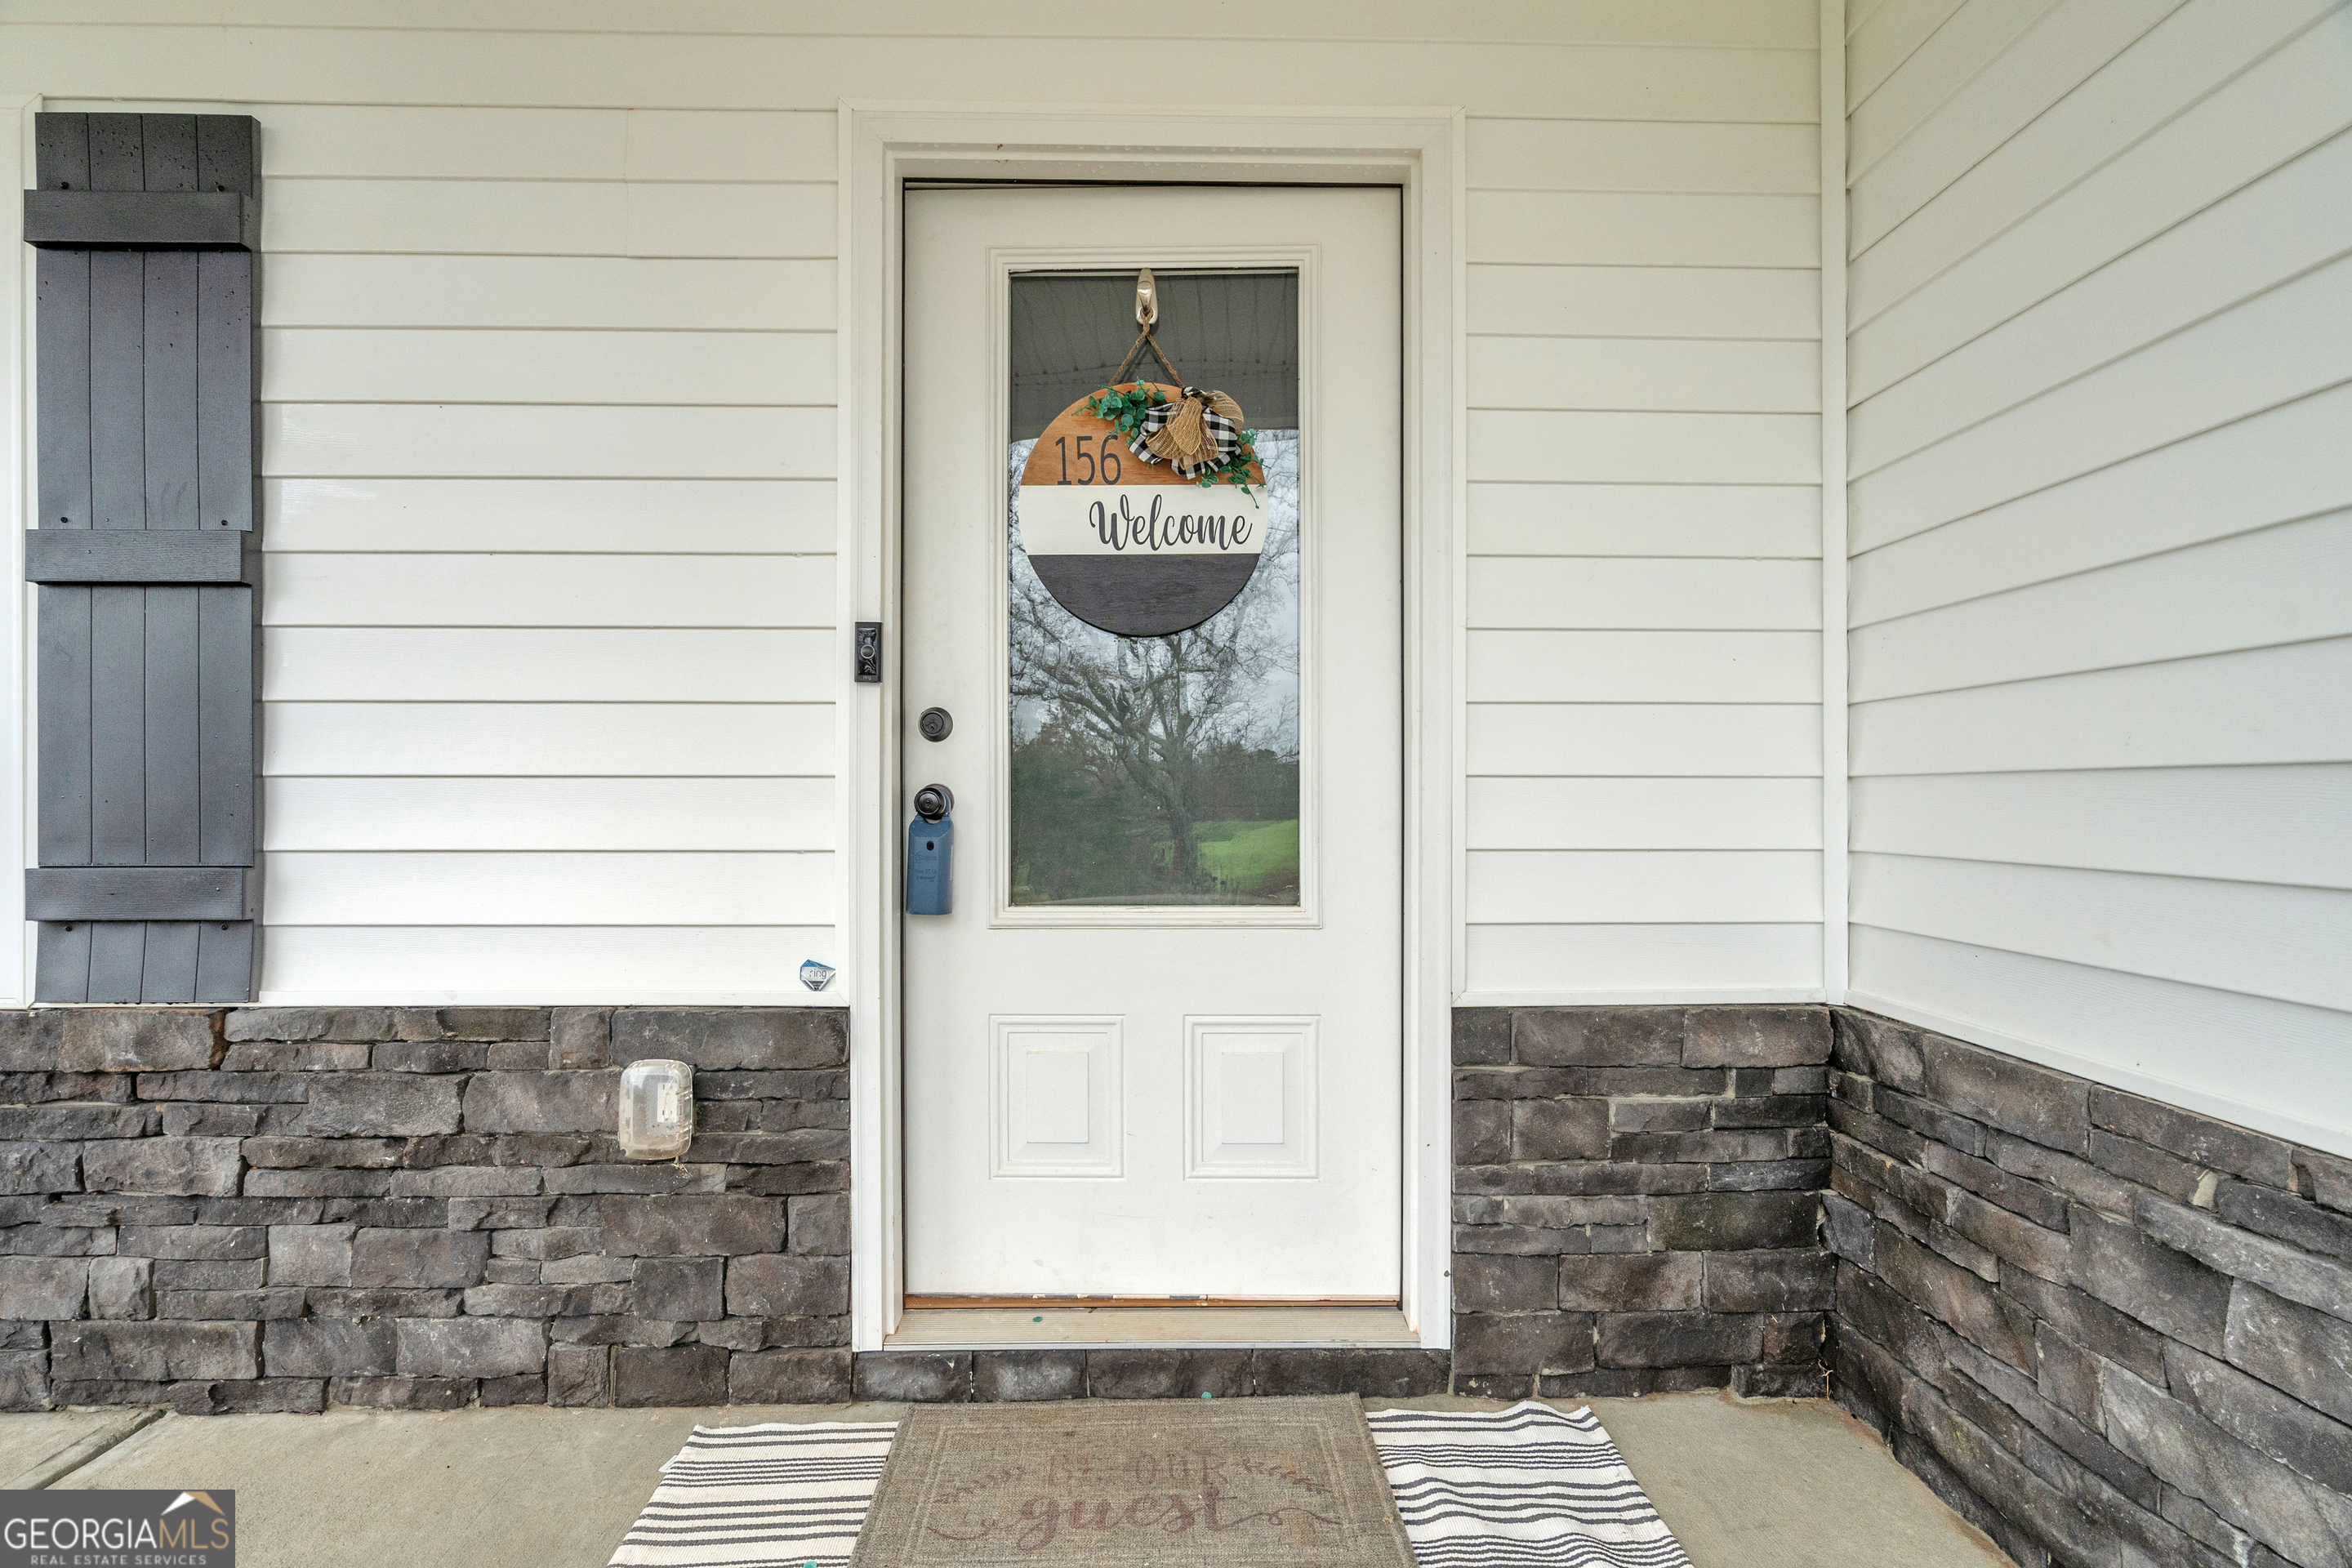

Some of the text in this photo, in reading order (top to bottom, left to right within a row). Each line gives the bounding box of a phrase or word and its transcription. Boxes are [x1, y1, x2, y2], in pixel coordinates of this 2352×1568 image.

[1055, 434, 1121, 486] 156
[1089, 493, 1253, 551] Welcome
[809, 968, 827, 980] ring
[1011, 1486, 1258, 1552] guest
